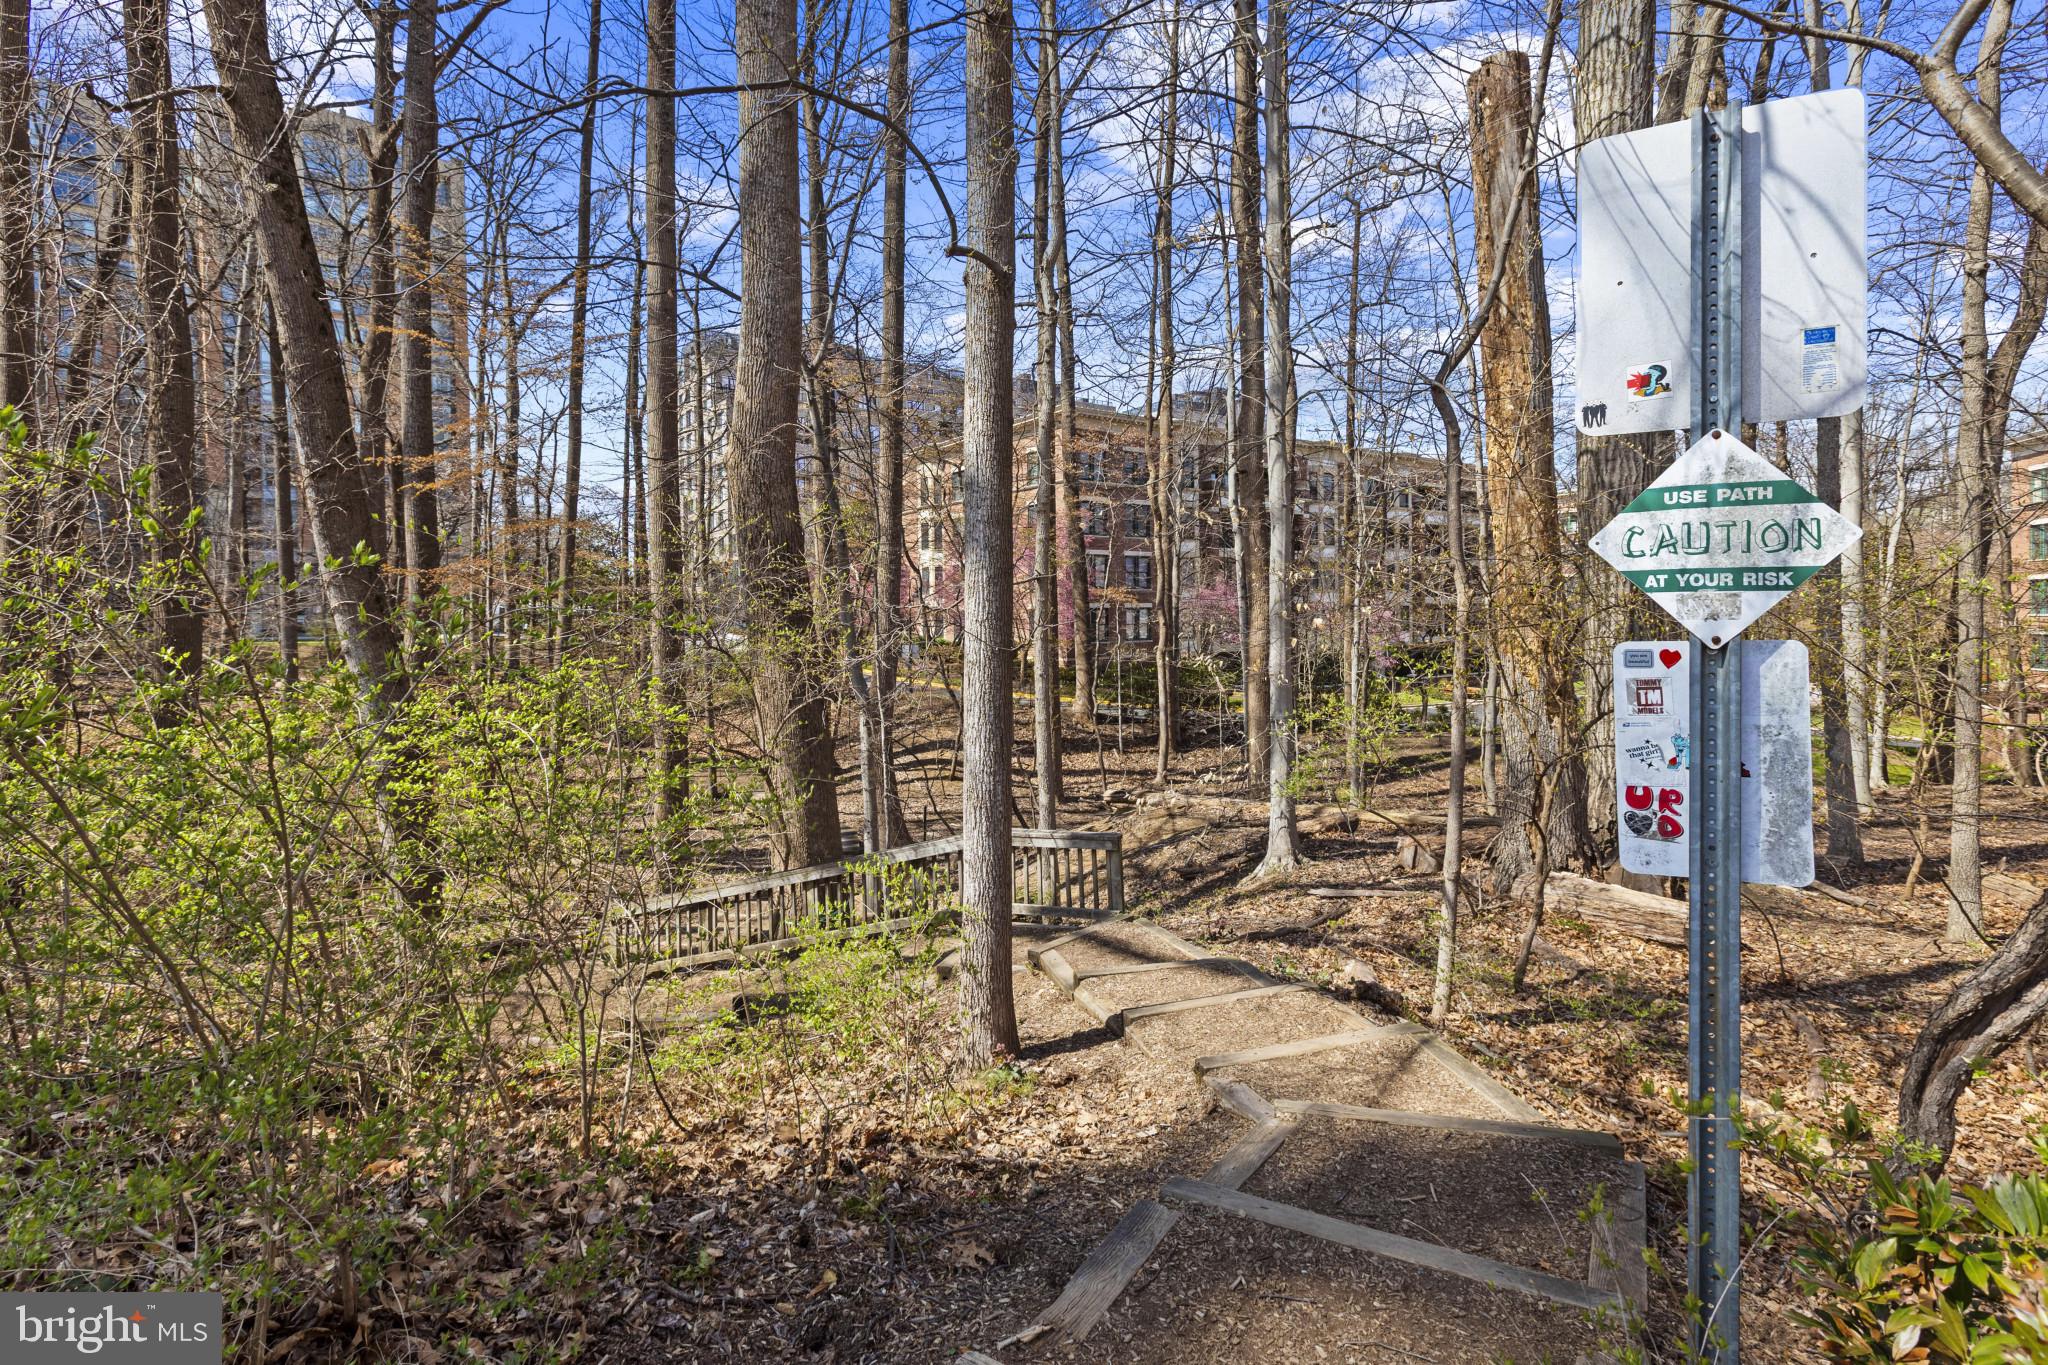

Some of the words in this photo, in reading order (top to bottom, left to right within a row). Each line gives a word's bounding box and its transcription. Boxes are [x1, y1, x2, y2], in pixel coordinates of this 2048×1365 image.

[1663, 490, 1707, 504] USE
[1717, 486, 1773, 502] PATH
[1621, 518, 1822, 558] CAUTION
[1645, 574, 1668, 588] AT
[1676, 573, 1733, 587] YOUR
[1743, 571, 1794, 586] RISK
